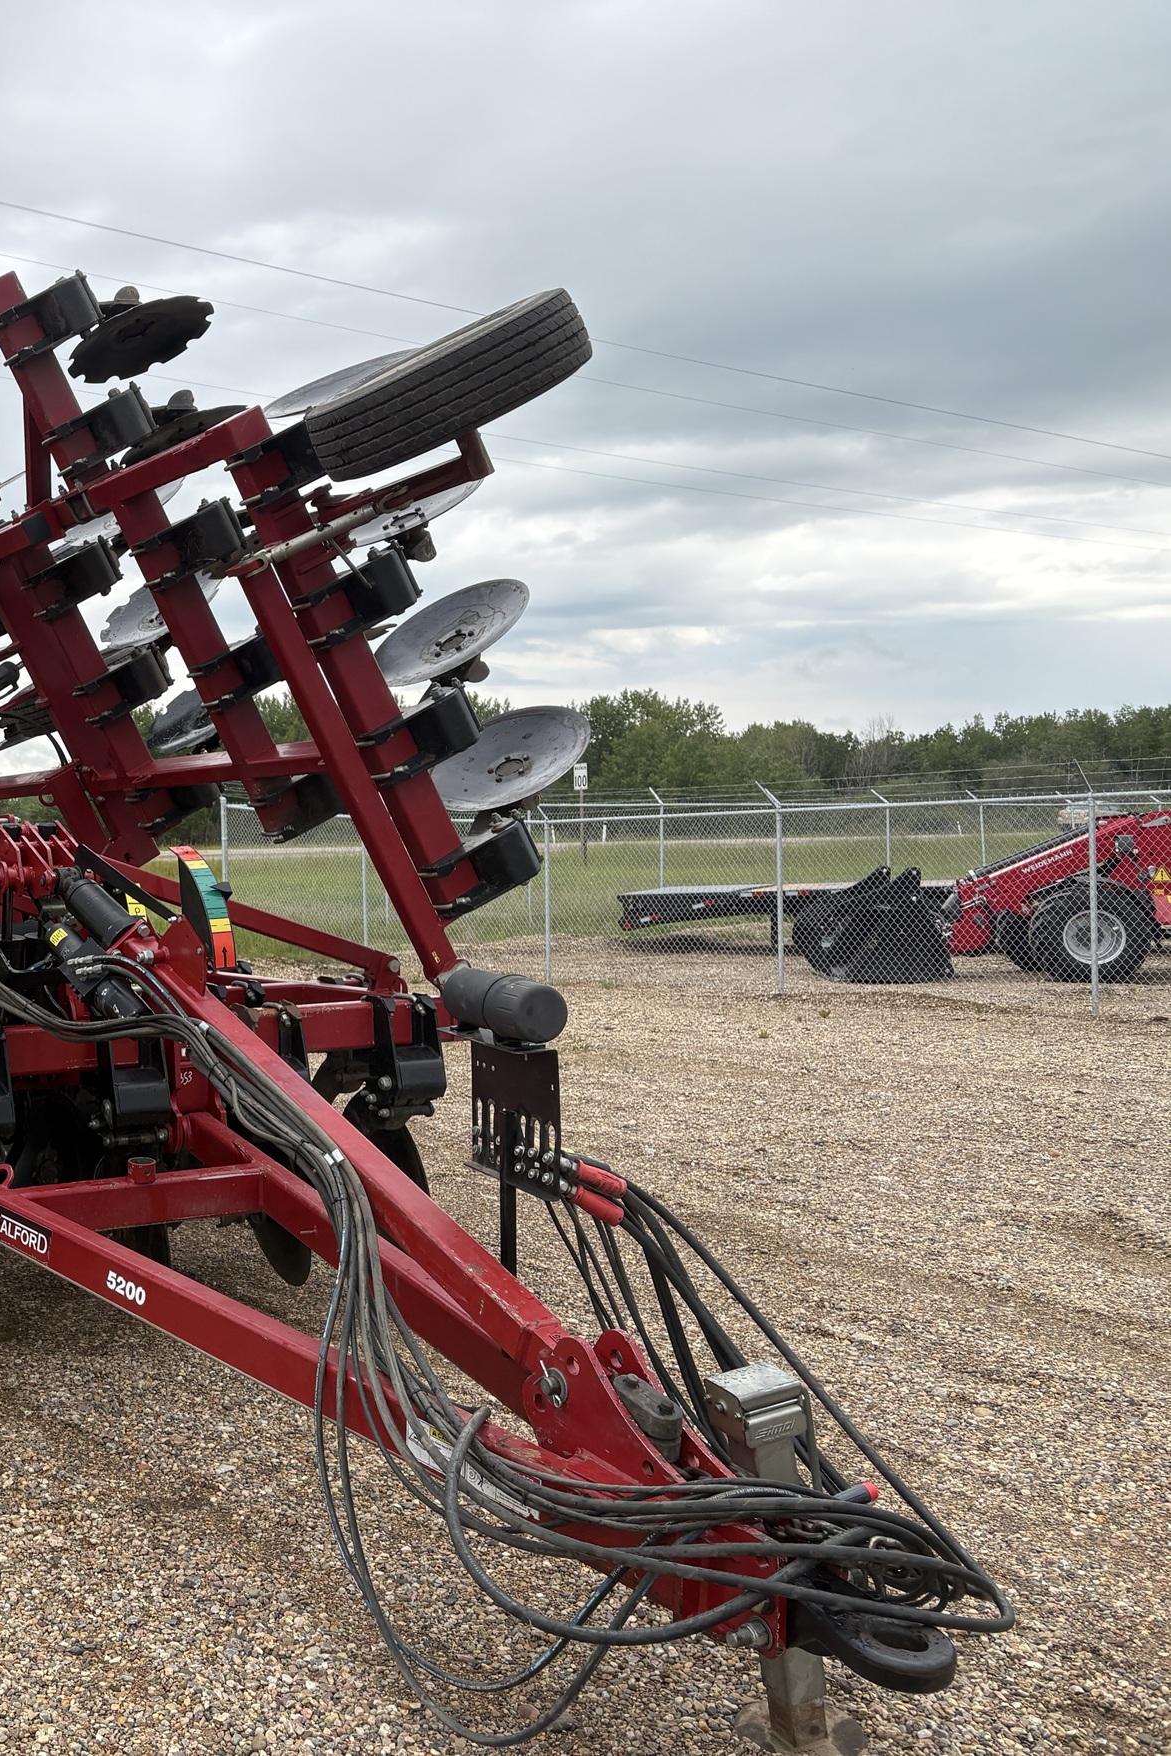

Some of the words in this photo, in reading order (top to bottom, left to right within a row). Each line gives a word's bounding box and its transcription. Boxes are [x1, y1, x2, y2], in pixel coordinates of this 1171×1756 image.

[575, 775, 586, 787] 100
[1021, 848, 1073, 874] WEIDEMANN
[105, 1269, 146, 1306] 5200
